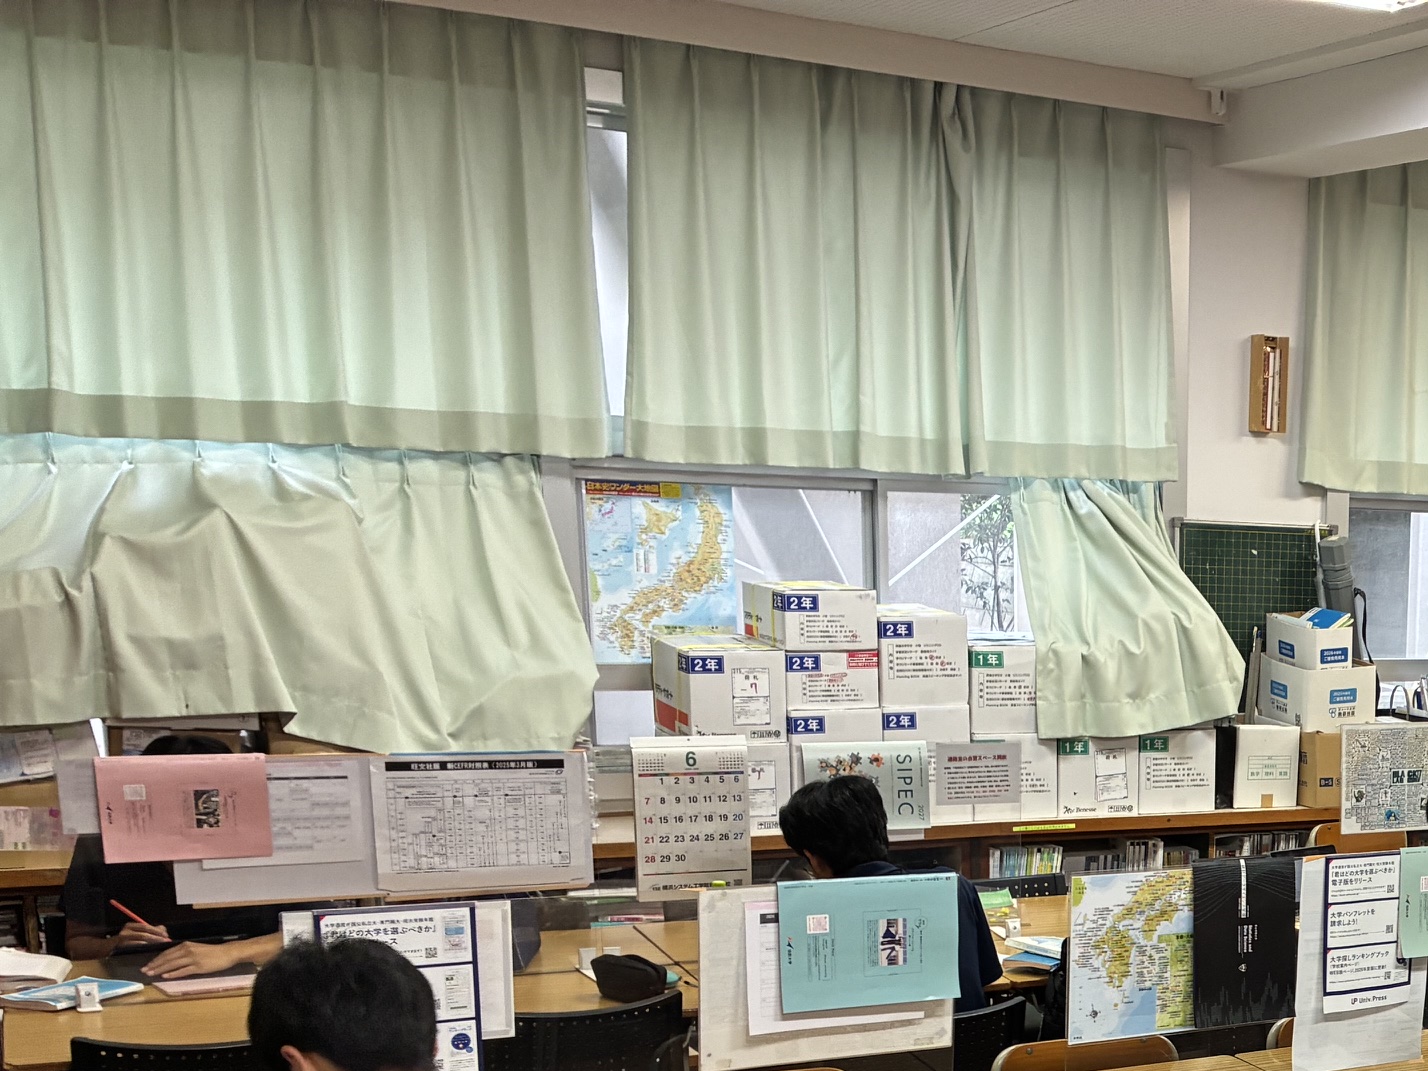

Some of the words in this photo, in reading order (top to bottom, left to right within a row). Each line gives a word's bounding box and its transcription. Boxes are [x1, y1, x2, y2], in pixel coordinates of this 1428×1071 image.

[586, 481, 659, 493] 日本史ワンダー大地図
[790, 596, 813, 610] 2年
[886, 623, 909, 636] 2年
[694, 659, 719, 671] 2年
[792, 655, 816, 670] 2年
[978, 653, 999, 666] 1年
[797, 718, 821, 732] 2年
[888, 714, 911, 728] 2年
[1064, 742, 1084, 754] 1年
[1145, 739, 1164, 750] 1年
[686, 752, 696, 766] 6
[674, 776, 680, 785] 2
[689, 776, 695, 784] 3
[704, 776, 710, 784] 4
[719, 776, 725, 784] 5
[734, 775, 740, 783] 6
[896, 754, 914, 816] SIPEC
[644, 797, 650, 805] 7
[660, 797, 666, 805] 8
[675, 796, 681, 804] 9
[688, 796, 698, 804] 10
[703, 795, 712, 803] 11
[718, 794, 728, 802] 12
[732, 794, 742, 802] 13
[643, 816, 653, 824] 14
[659, 816, 669, 824] 15
[674, 815, 684, 823] 16
[688, 815, 698, 823] 17
[704, 814, 714, 822] 18
[718, 814, 728, 822] 19
[732, 813, 744, 821] 20
[917, 805, 925, 821] 2027
[644, 836, 654, 844] 21
[659, 835, 670, 844] 22
[674, 835, 685, 843] 23
[689, 834, 700, 842] 24
[704, 833, 715, 842] 25
[719, 833, 730, 841] 26
[733, 832, 744, 840] 27
[644, 855, 656, 863] 28
[660, 854, 671, 863] 29
[675, 854, 686, 862] 30
[1331, 878, 1372, 886] 電子版をリリース
[1330, 909, 1375, 919] 大学パンフレットを
